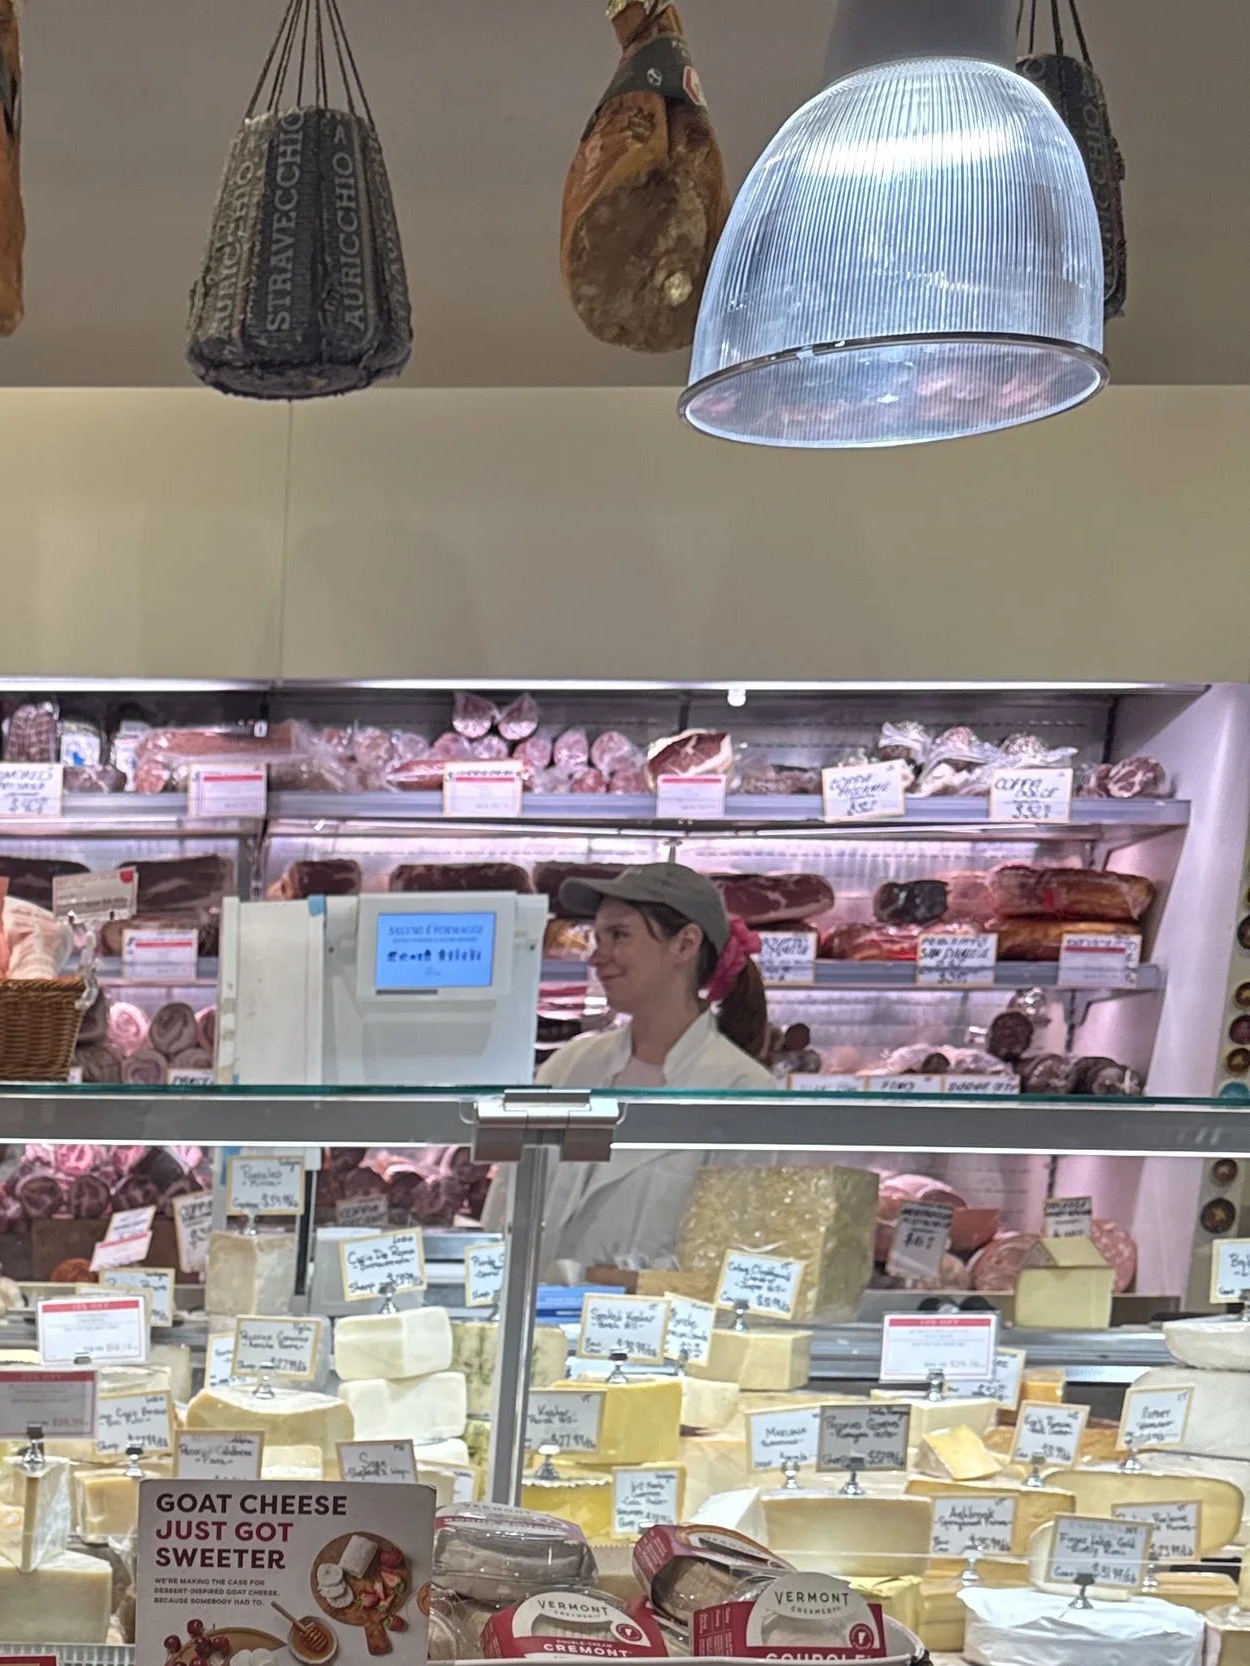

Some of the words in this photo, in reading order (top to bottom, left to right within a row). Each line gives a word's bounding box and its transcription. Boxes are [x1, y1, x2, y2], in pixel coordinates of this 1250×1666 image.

[265, 110, 303, 332] STRAVECCHIO
[332, 152, 365, 330] AURICCHIO
[155, 1493, 233, 1514] GOAT
[239, 1494, 348, 1516] CHEESE
[155, 1520, 228, 1541] JUST
[234, 1521, 294, 1542] GOT
[155, 1547, 286, 1569] SWEETER
[154, 1577, 178, 1585] WE'RE
[180, 1577, 210, 1586] MAKING
[211, 1578, 225, 1586] THE
[227, 1578, 248, 1586] CASE
[154, 1597, 188, 1606] BECAUSE
[190, 1598, 231, 1606] SOMEBODY
[233, 1598, 250, 1607] HAD
[537, 1599, 609, 1616] VERMONT
[775, 1591, 849, 1607] VERMONT
[543, 1643, 629, 1658] CREMONT
